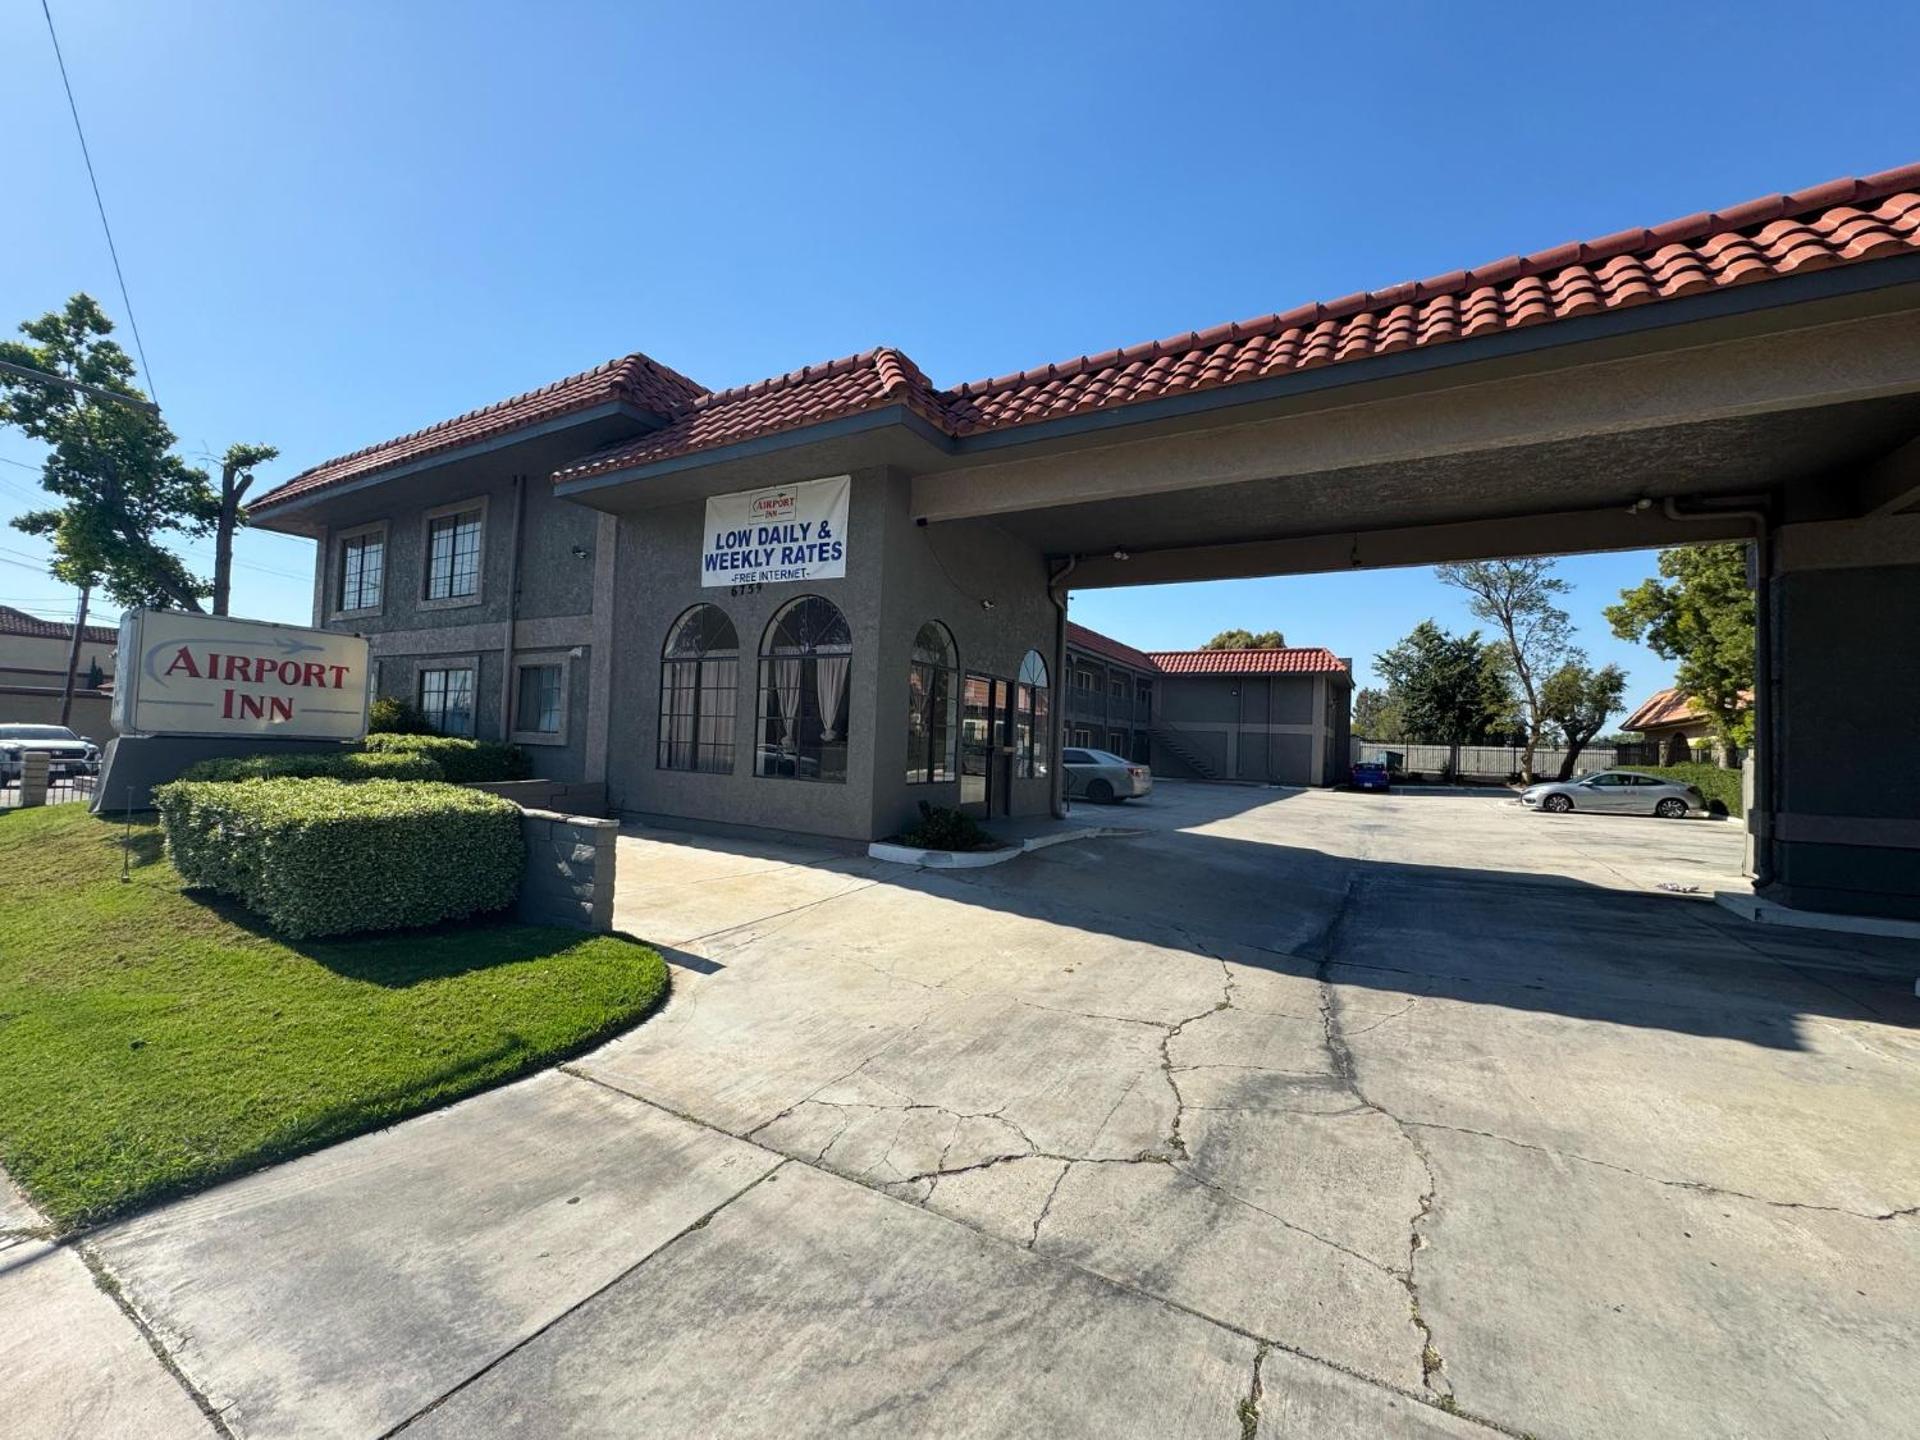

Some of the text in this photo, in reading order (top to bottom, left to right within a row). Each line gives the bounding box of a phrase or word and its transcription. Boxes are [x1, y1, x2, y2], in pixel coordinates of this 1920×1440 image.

[757, 497, 795, 511] AIRPORT
[765, 510, 777, 518] INN
[716, 520, 832, 550] LOW DAILY &
[705, 541, 842, 571] WEEKLY RATES
[164, 646, 350, 689] AIRPORT
[221, 689, 294, 721] INN
